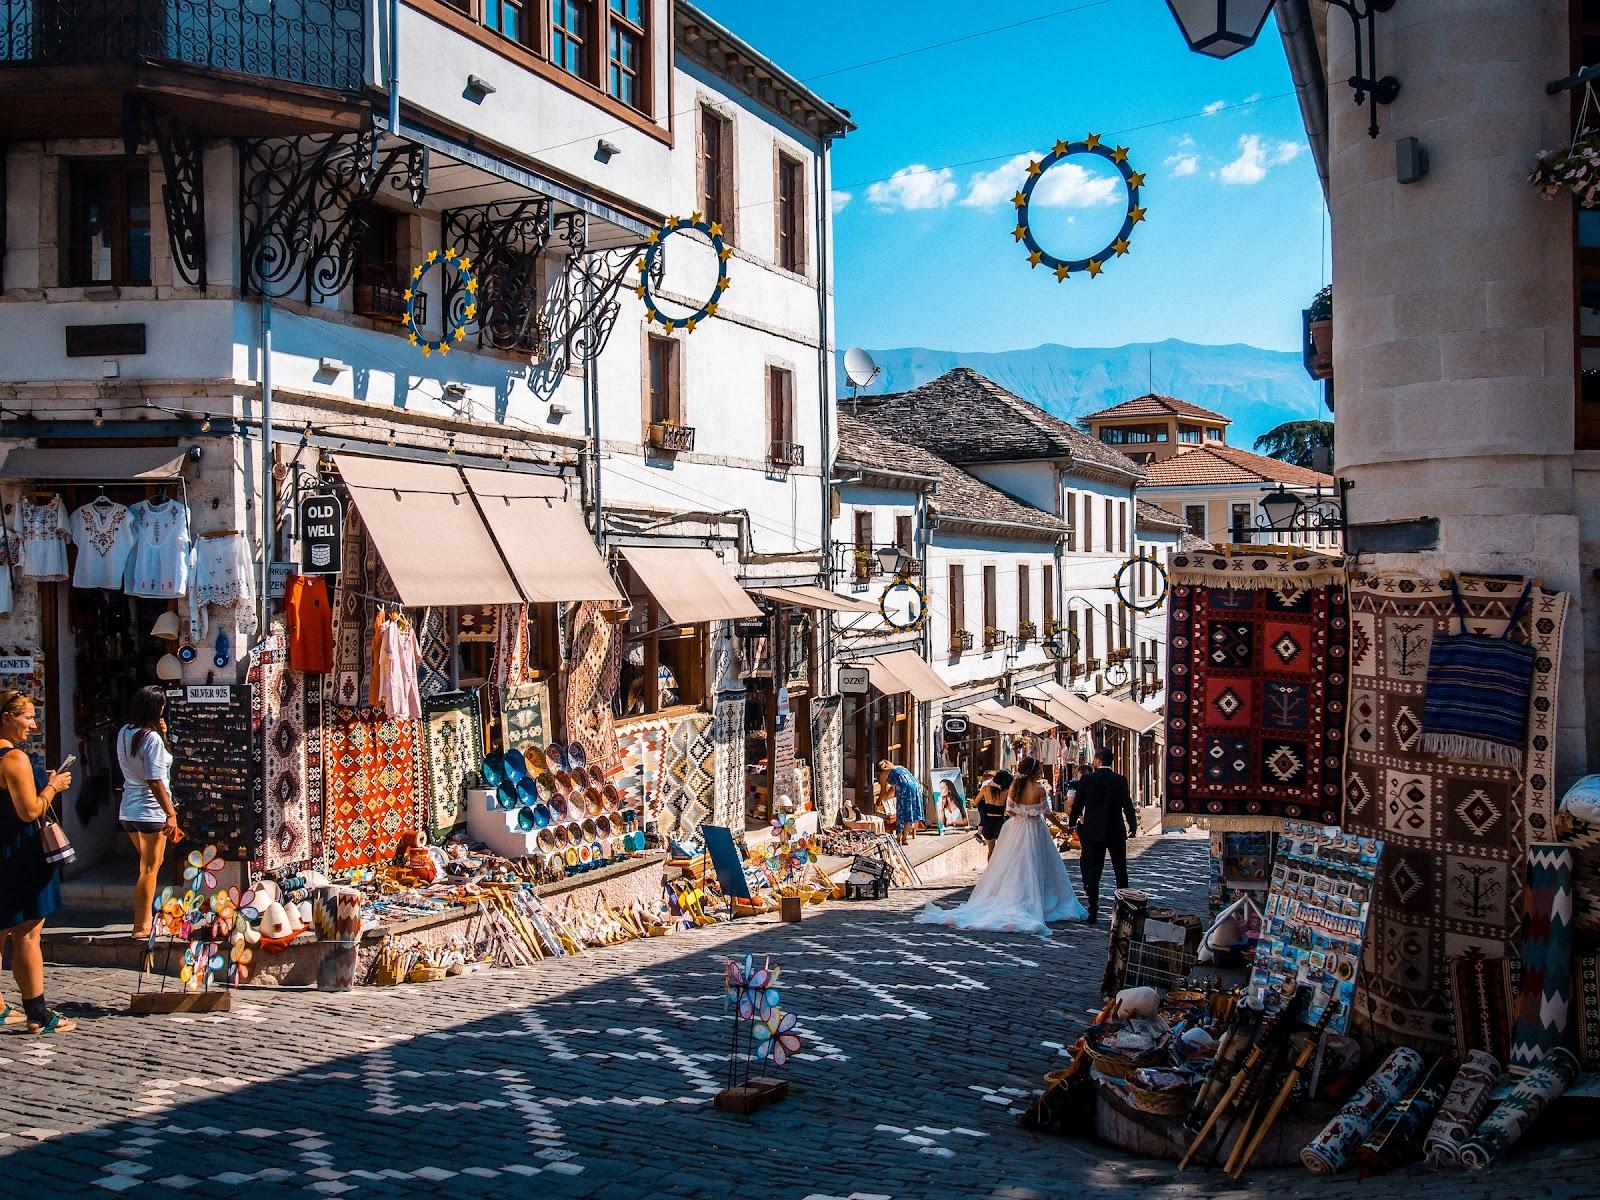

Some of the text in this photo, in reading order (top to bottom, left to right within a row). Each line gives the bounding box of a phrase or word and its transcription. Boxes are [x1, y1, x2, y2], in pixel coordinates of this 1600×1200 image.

[308, 505, 334, 519] OLD
[307, 524, 335, 538] WELL
[269, 582, 286, 590] ZEN
[0, 659, 30, 669] GNETS
[190, 688, 215, 698] SILVER
[215, 688, 228, 698] 925
